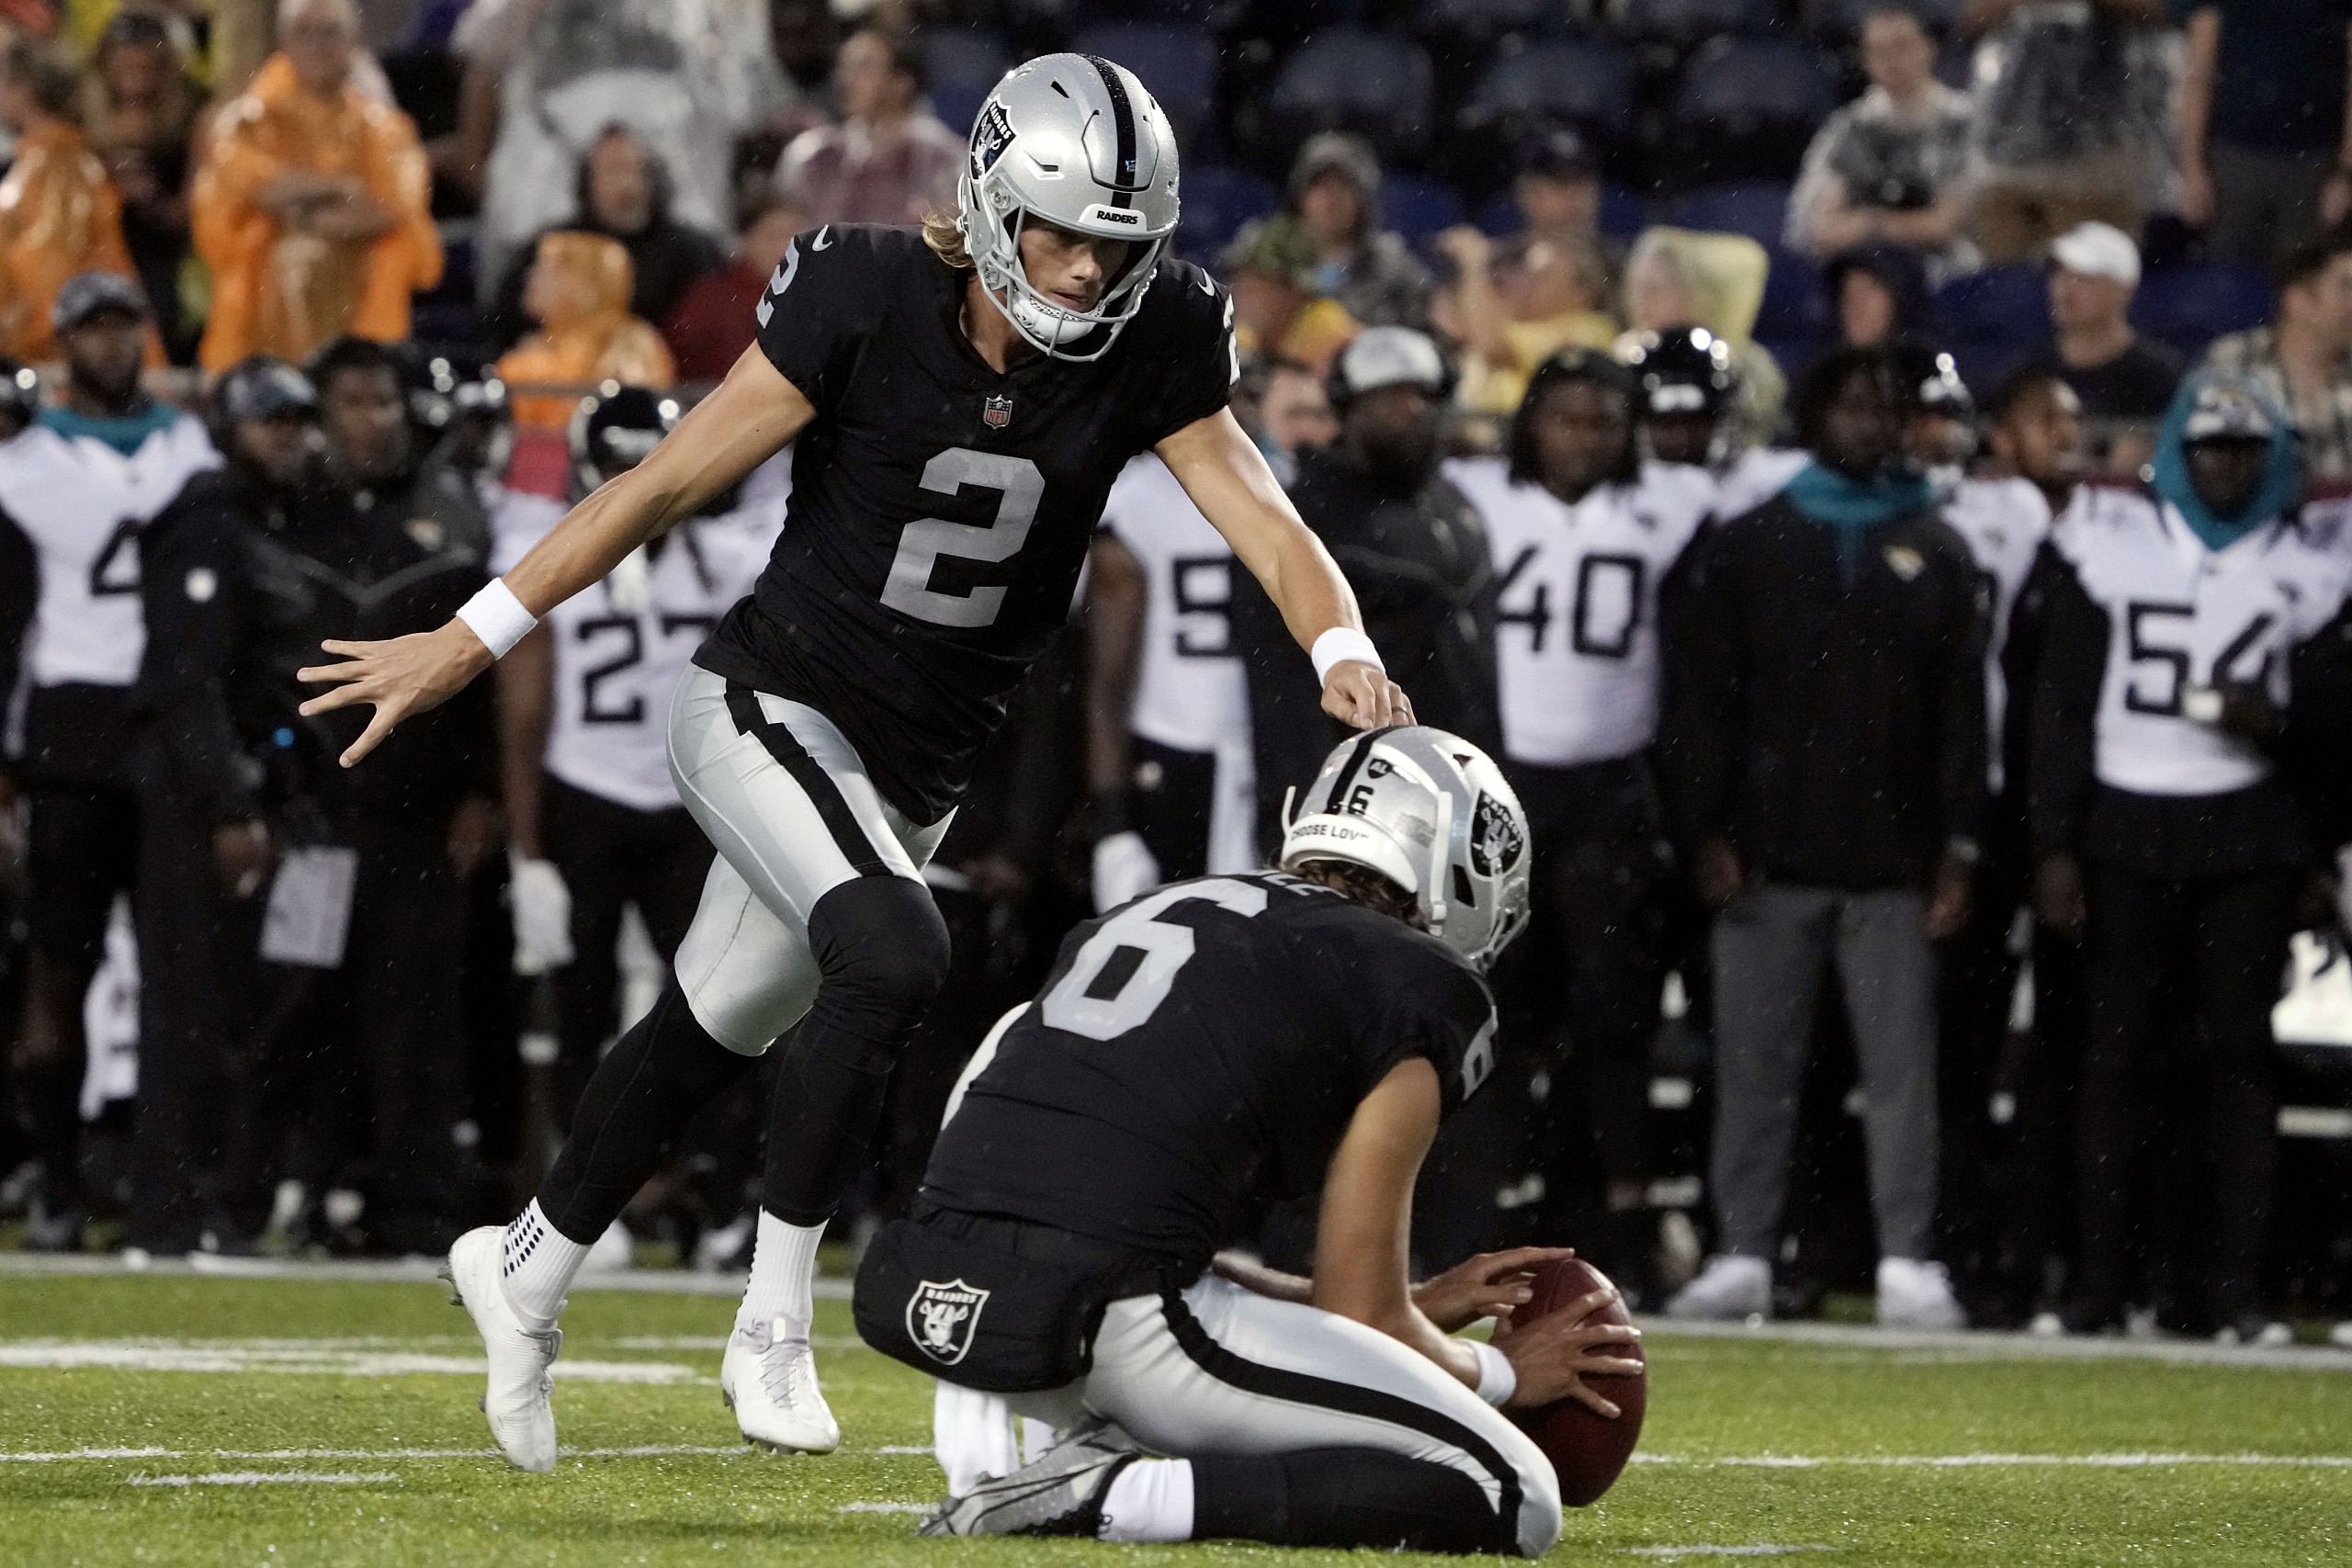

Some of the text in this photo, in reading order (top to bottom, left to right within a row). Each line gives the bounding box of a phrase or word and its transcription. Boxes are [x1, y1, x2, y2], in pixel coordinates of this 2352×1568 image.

[989, 102, 1012, 140] RAIDERS
[1096, 209, 1138, 225] RAIDERS
[755, 236, 799, 329] 2
[880, 446, 1046, 627] 2
[1496, 546, 1642, 659] 40
[1347, 784, 1375, 816] 6
[1330, 826, 1369, 841] LOV
[1042, 878, 1268, 1042] 6
